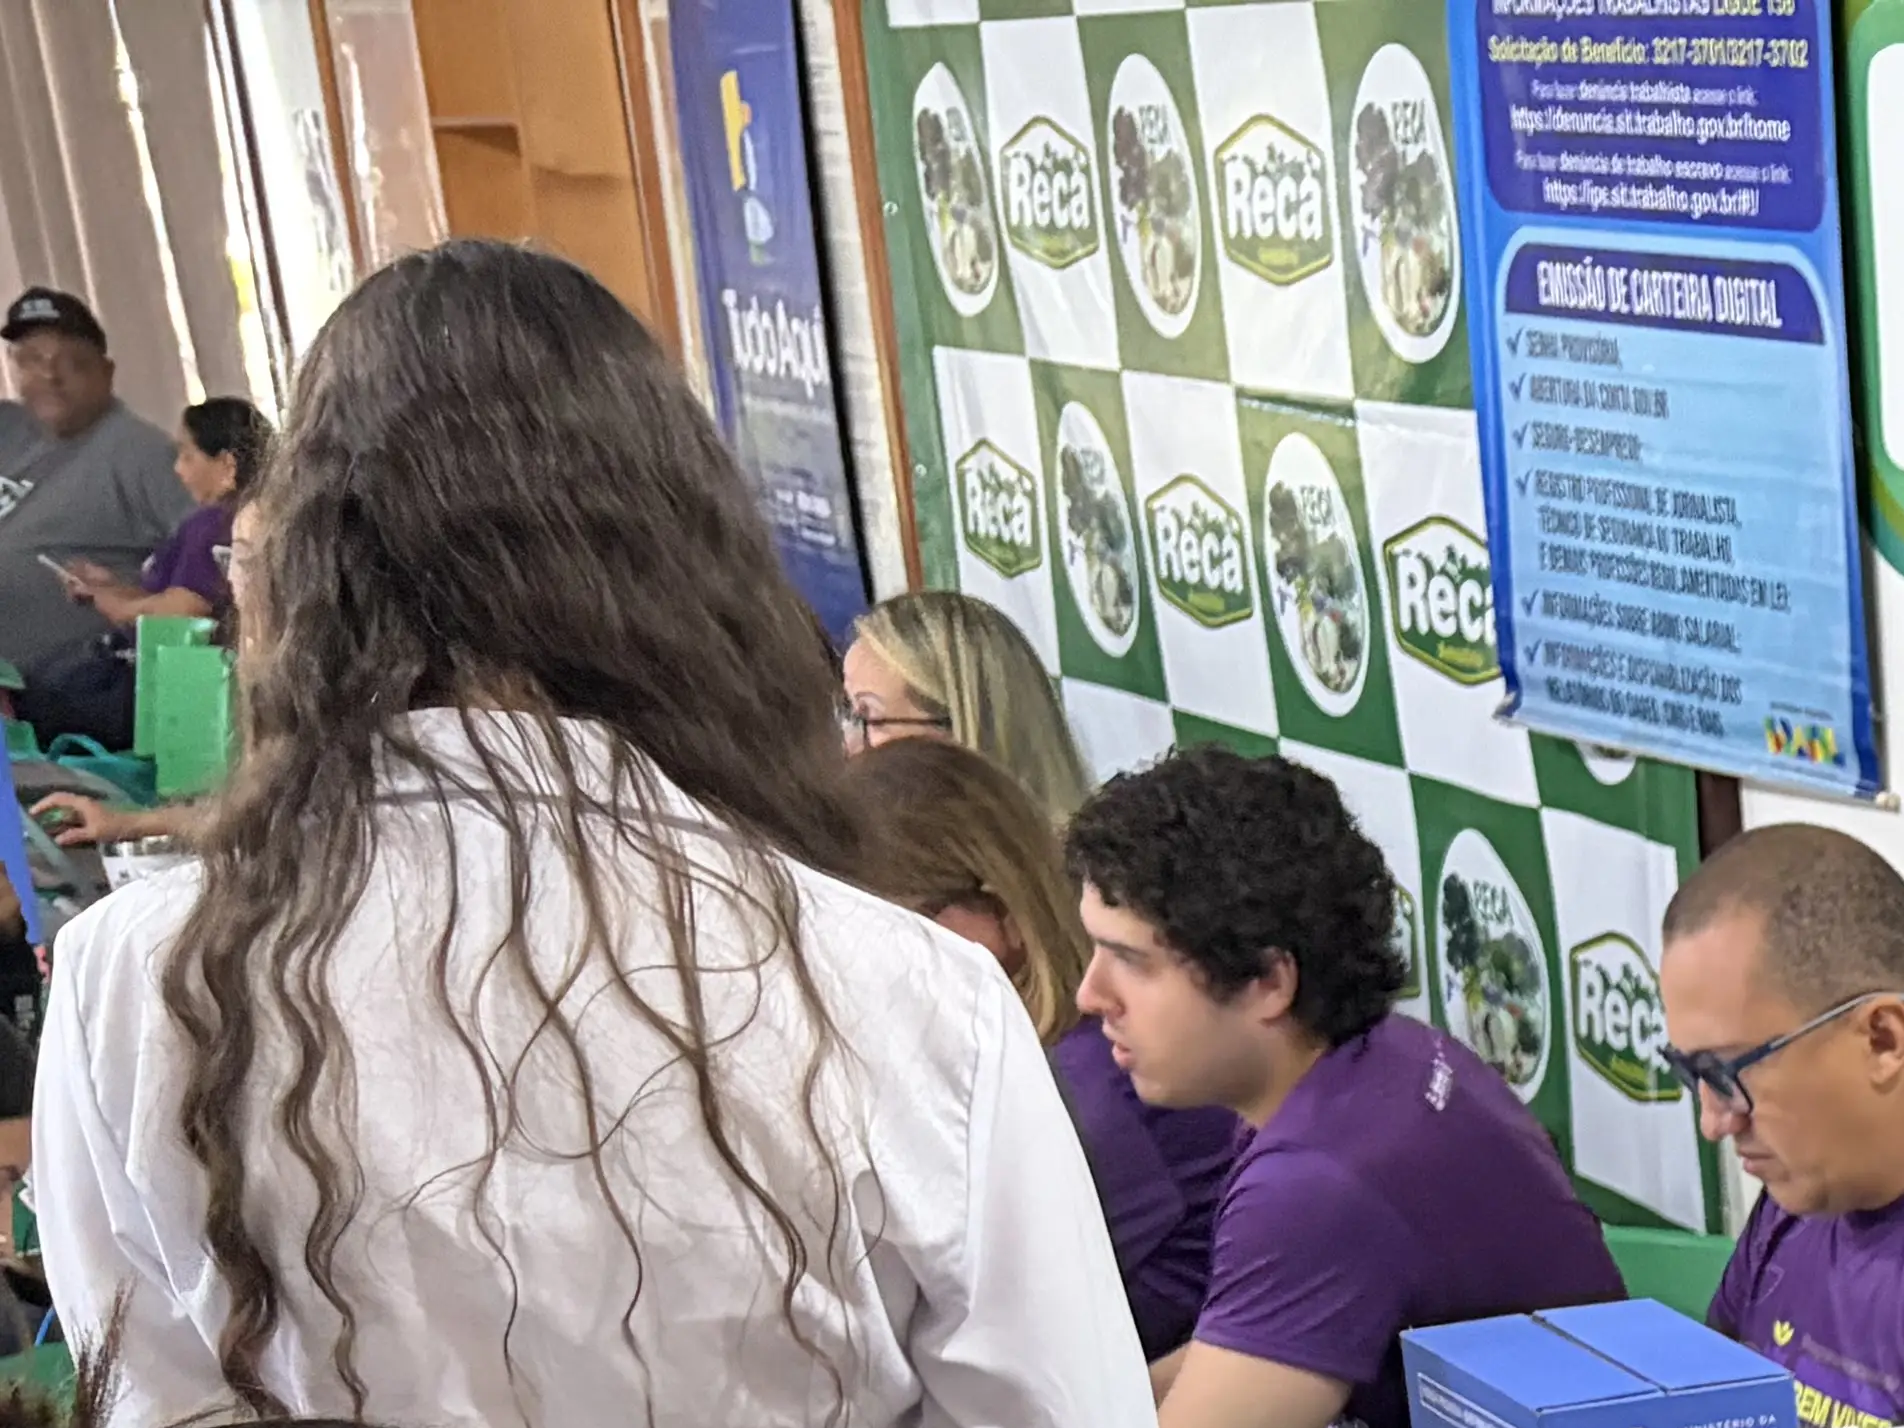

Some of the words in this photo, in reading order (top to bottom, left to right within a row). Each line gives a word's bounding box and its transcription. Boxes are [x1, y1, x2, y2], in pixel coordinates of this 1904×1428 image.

[1008, 155, 1090, 229] Reca
[1225, 157, 1323, 241] Reca
[1606, 266, 1629, 313] DE
[1630, 269, 1712, 321] CARTEIRA
[1714, 275, 1782, 328] DIGITAL
[1155, 507, 1243, 594] Reca
[1760, 1414, 1777, 1427] DA
